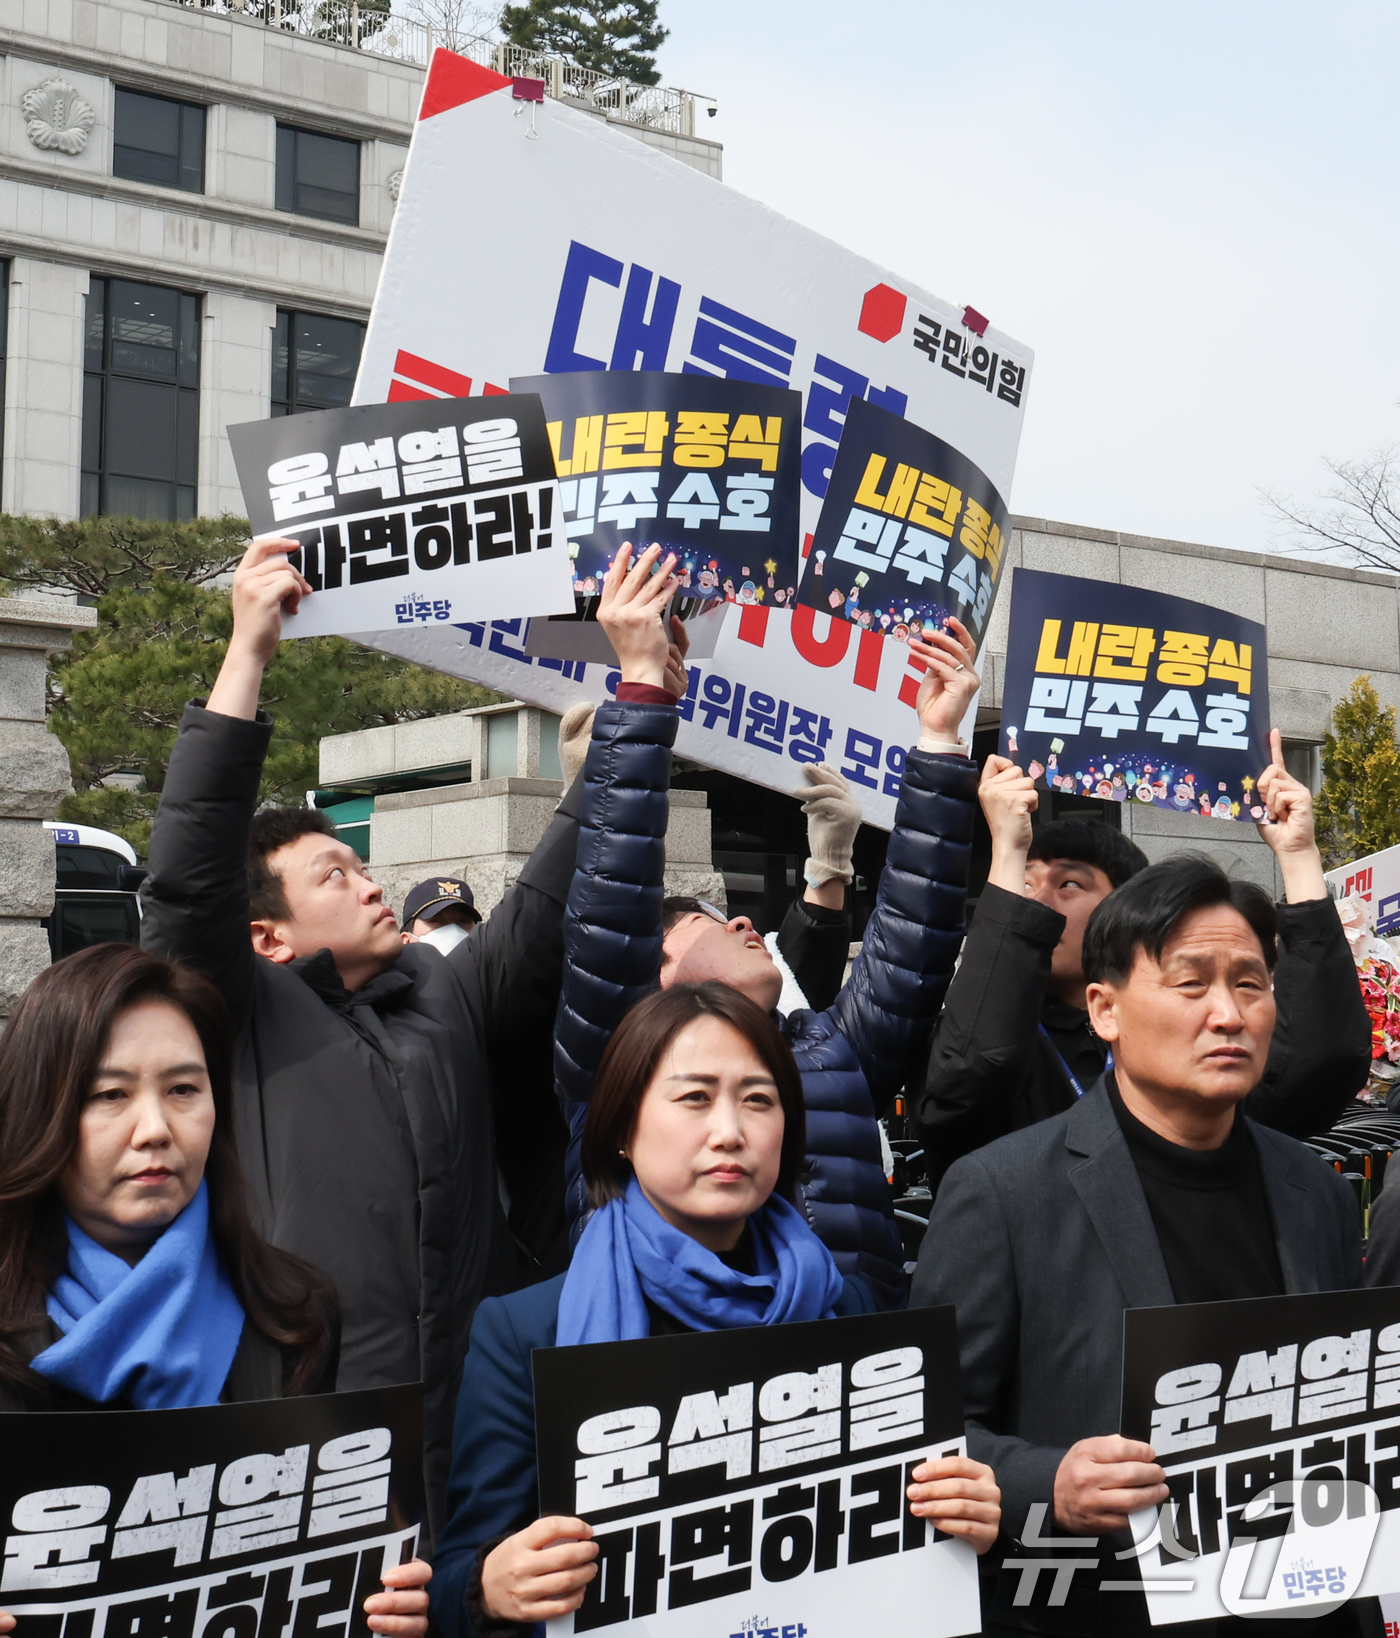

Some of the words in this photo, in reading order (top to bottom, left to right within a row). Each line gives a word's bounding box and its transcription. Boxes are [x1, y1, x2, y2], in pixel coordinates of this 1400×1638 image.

[913, 313, 1026, 408] 국민의힘
[267, 417, 524, 522] 윤석열을
[546, 411, 670, 477] 내란
[672, 411, 782, 472] 종식
[280, 486, 554, 592] 파면하라!
[666, 473, 771, 532] 수호
[853, 453, 962, 538] 내란
[959, 496, 1005, 584] 종식
[395, 599, 452, 624] 민주당
[832, 507, 950, 585] 민주
[947, 553, 993, 634] 수호
[1034, 618, 1156, 682] 내란
[1156, 630, 1253, 695] 종식
[1024, 677, 1144, 739] 민주
[1145, 688, 1251, 751] 수호
[575, 1346, 925, 1515] 윤석열을
[0, 1427, 392, 1592] 윤석열을
[1282, 1566, 1347, 1600] 민주당
